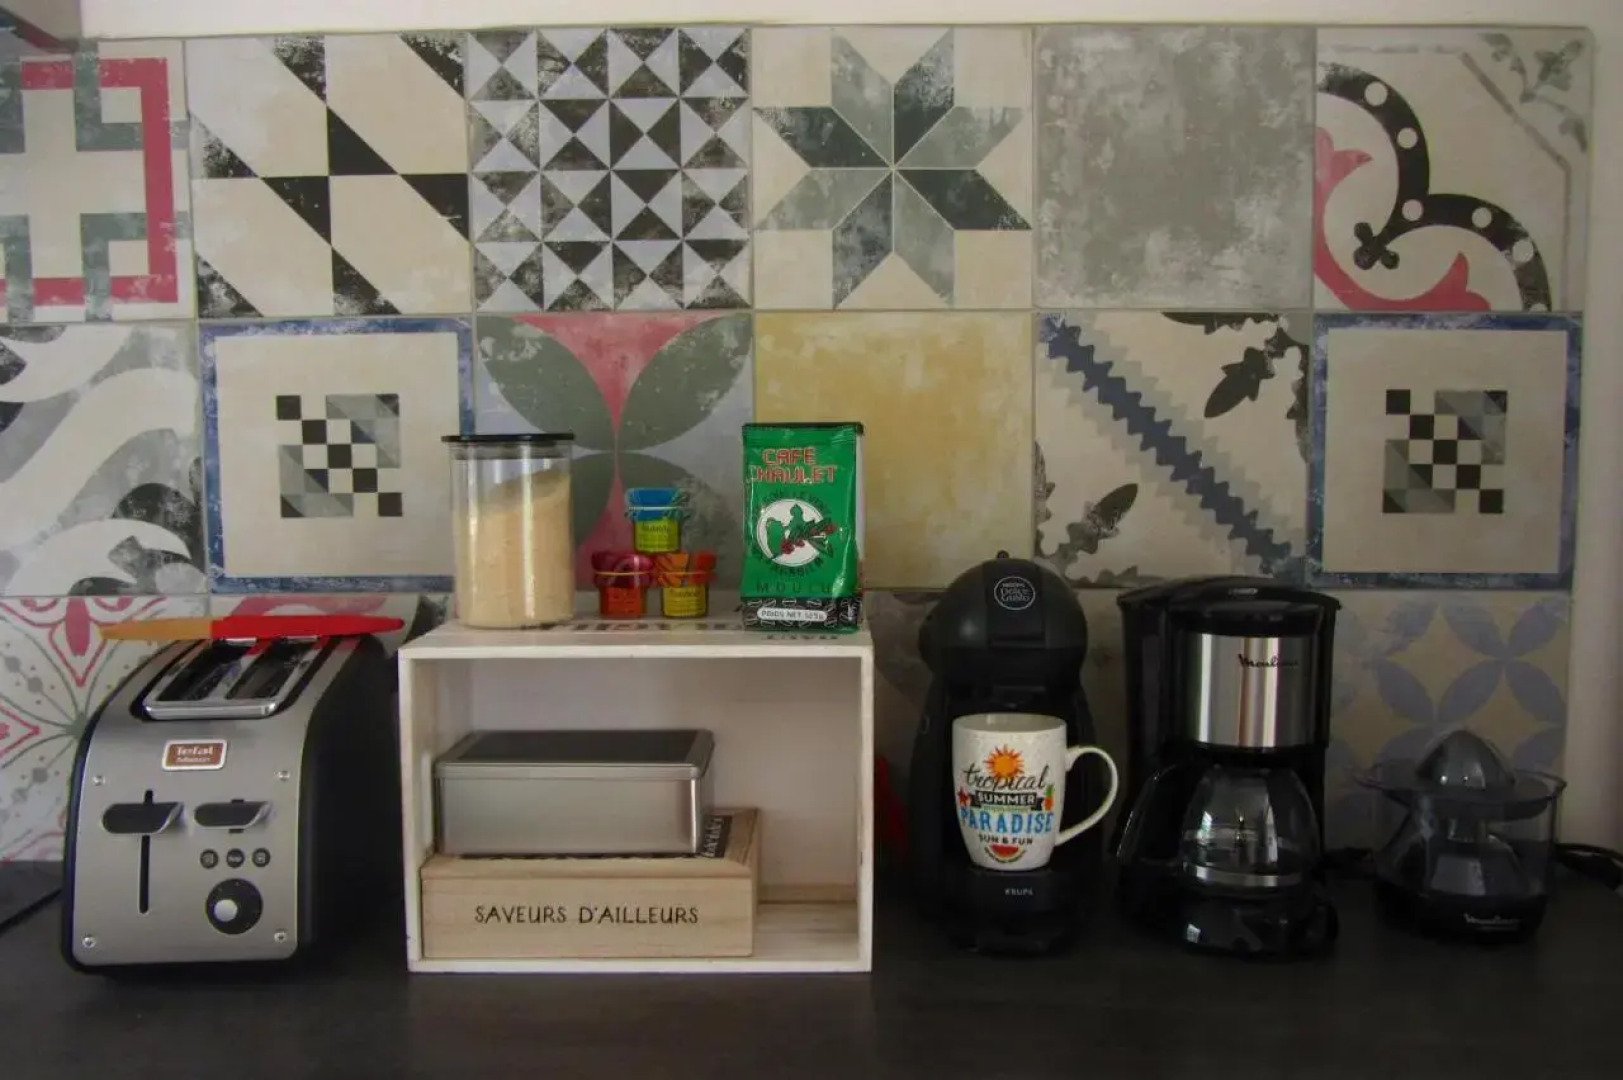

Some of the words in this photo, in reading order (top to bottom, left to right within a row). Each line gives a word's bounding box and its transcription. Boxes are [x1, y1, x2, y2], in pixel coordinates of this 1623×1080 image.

[762, 446, 816, 465] CAFE
[1238, 652, 1299, 668] Moul
[963, 762, 1049, 791] tropical
[978, 791, 1036, 805] SUMMER
[960, 808, 1054, 834] PARADISE
[979, 834, 999, 844] SUN
[1012, 836, 1033, 845] FUN
[474, 905, 567, 924] SAVEURS
[578, 905, 699, 924] D'AILLEURS
